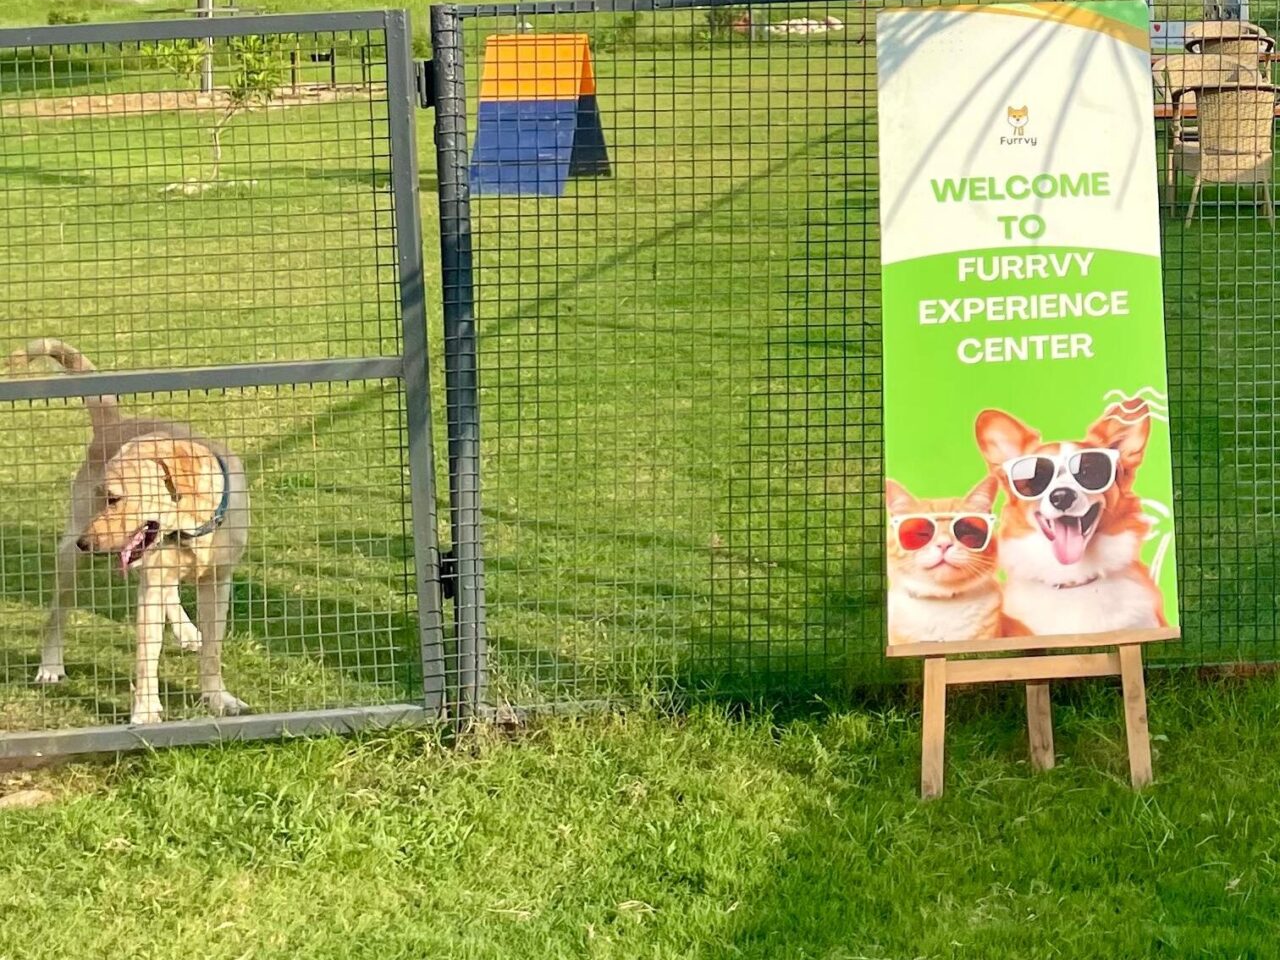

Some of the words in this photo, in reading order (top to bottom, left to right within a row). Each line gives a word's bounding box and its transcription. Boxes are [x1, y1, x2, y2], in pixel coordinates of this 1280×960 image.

[1000, 136, 1037, 146] Furrvy
[930, 172, 1110, 202] WELCOME
[997, 214, 1046, 240] TO
[958, 252, 1095, 282] FURRVY
[918, 290, 1129, 325] EXPERIENCE
[956, 333, 1095, 364] CENTER
